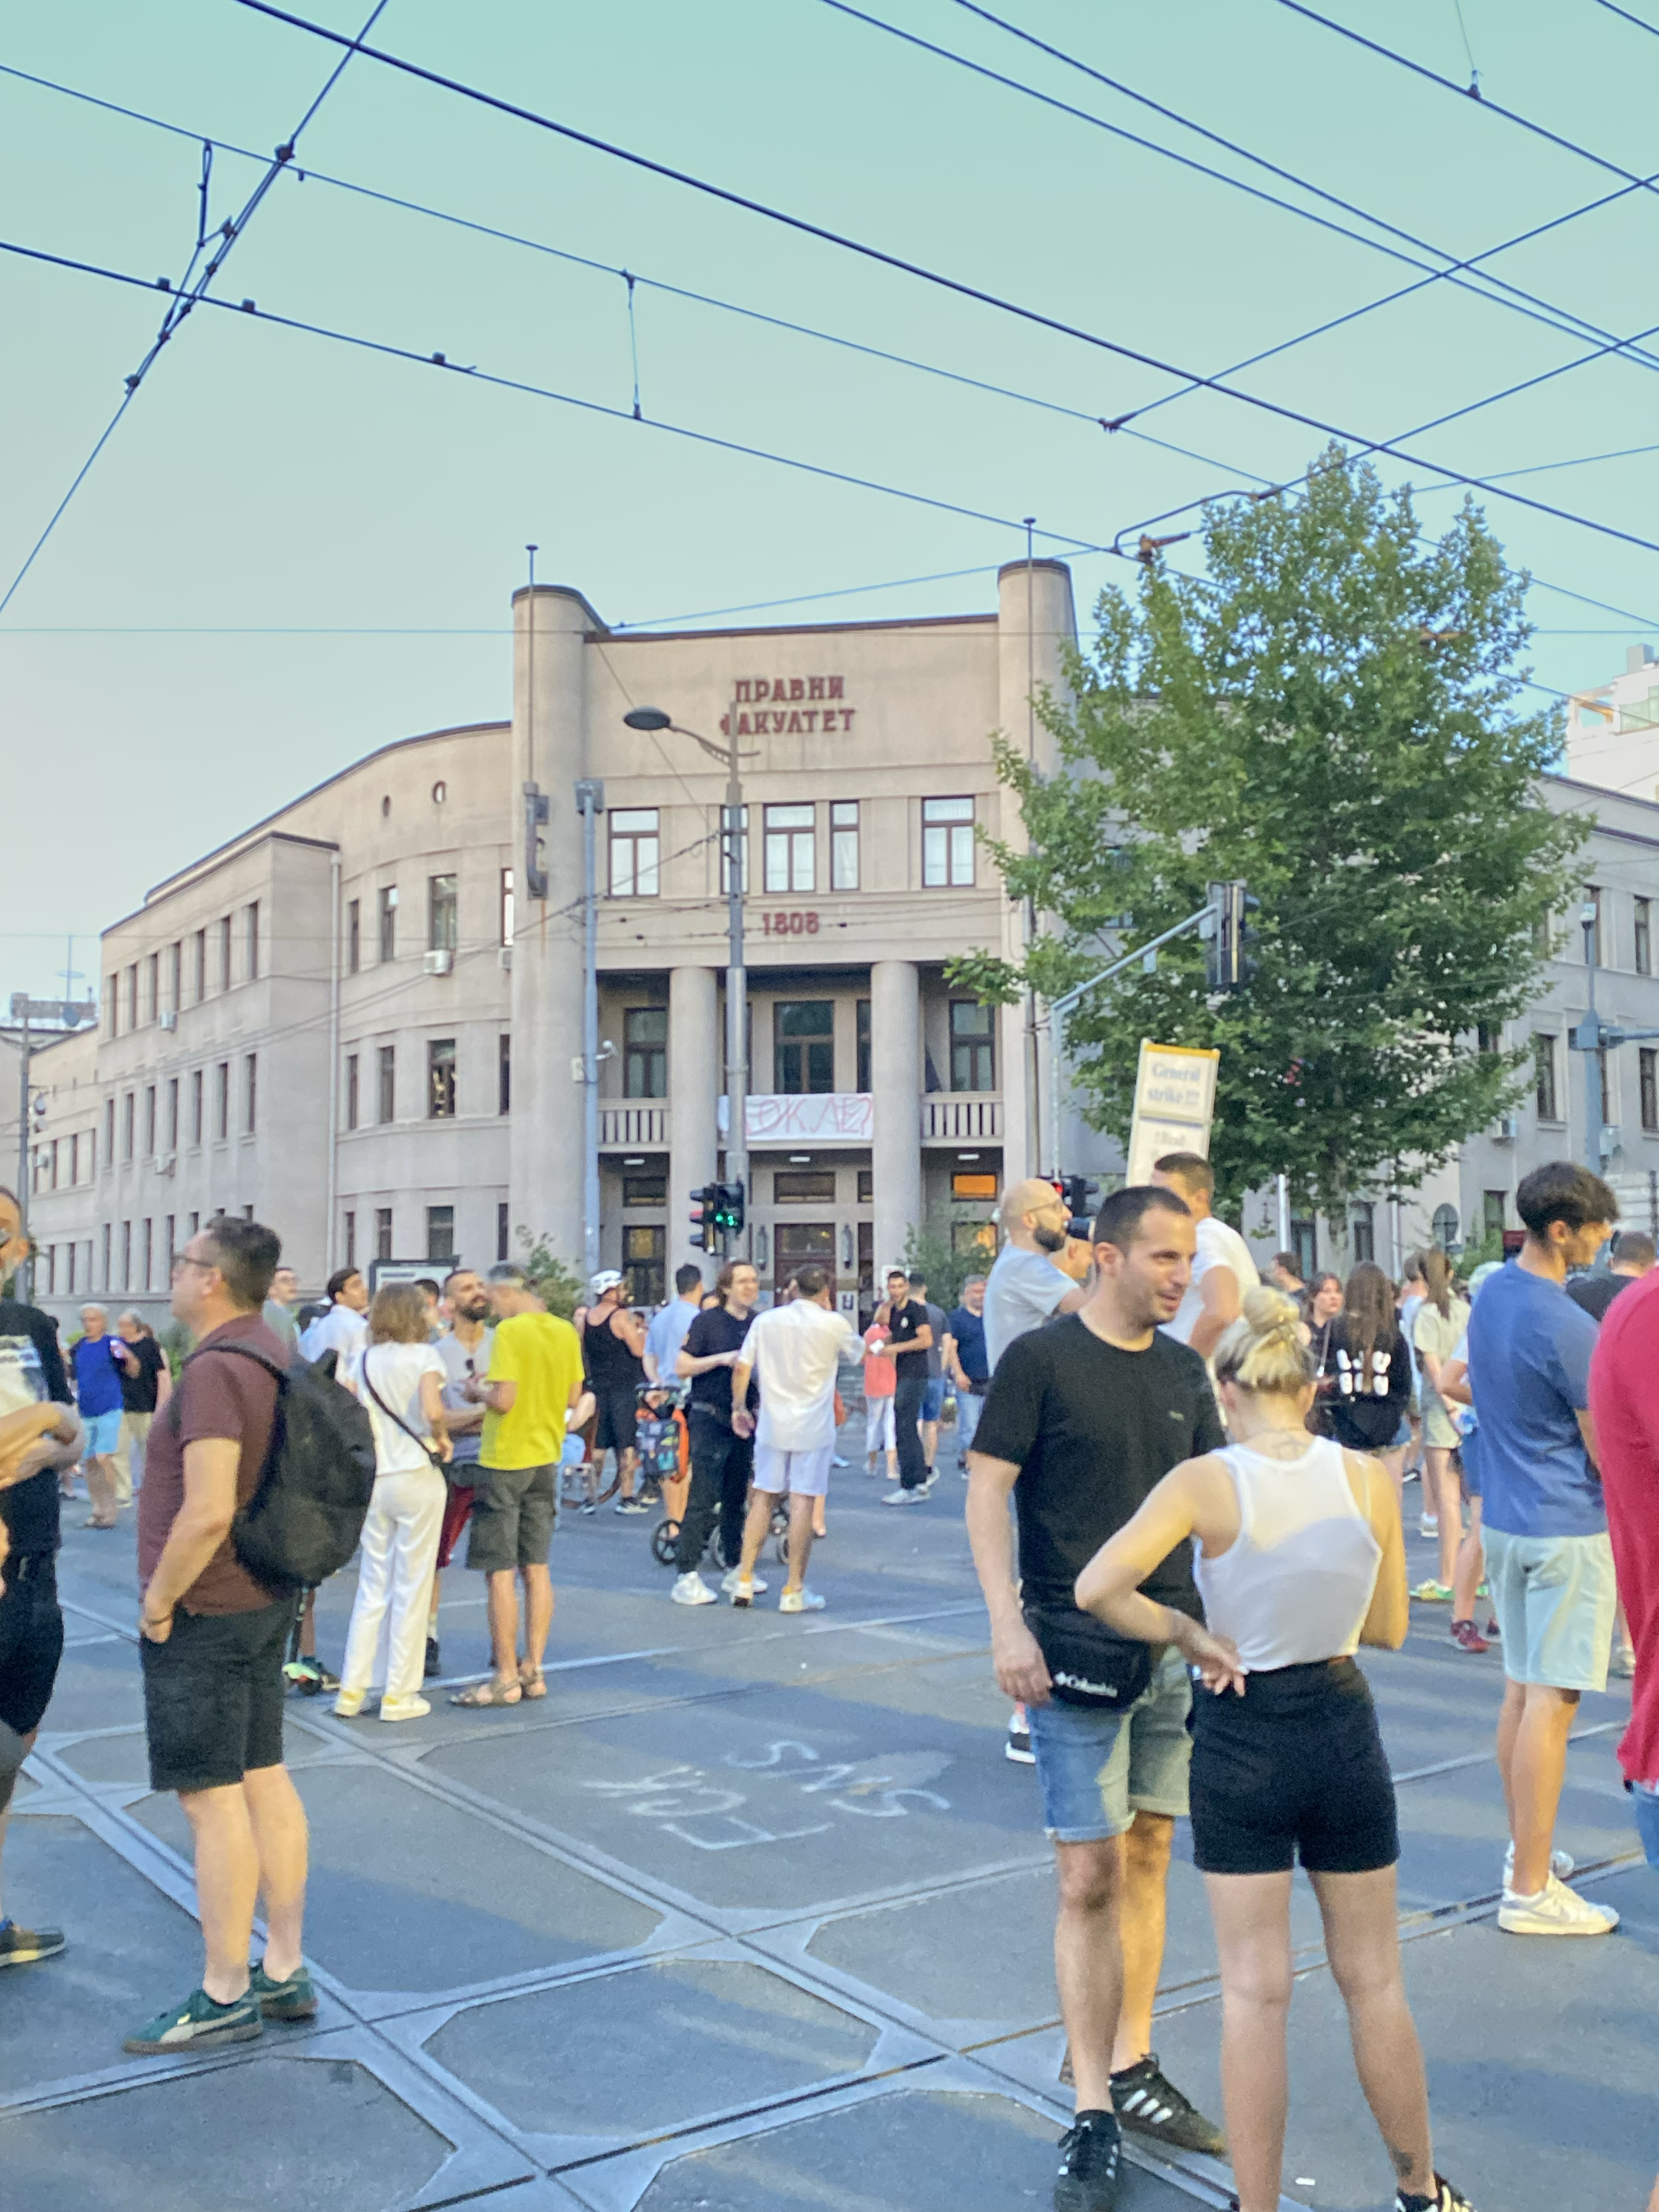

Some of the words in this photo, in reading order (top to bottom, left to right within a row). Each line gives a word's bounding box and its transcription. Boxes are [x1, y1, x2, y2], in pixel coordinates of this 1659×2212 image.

[735, 676, 844, 702] ПРАВНИ
[720, 708, 856, 736] ФАКУЛТЕТ
[763, 912, 819, 935] 1808
